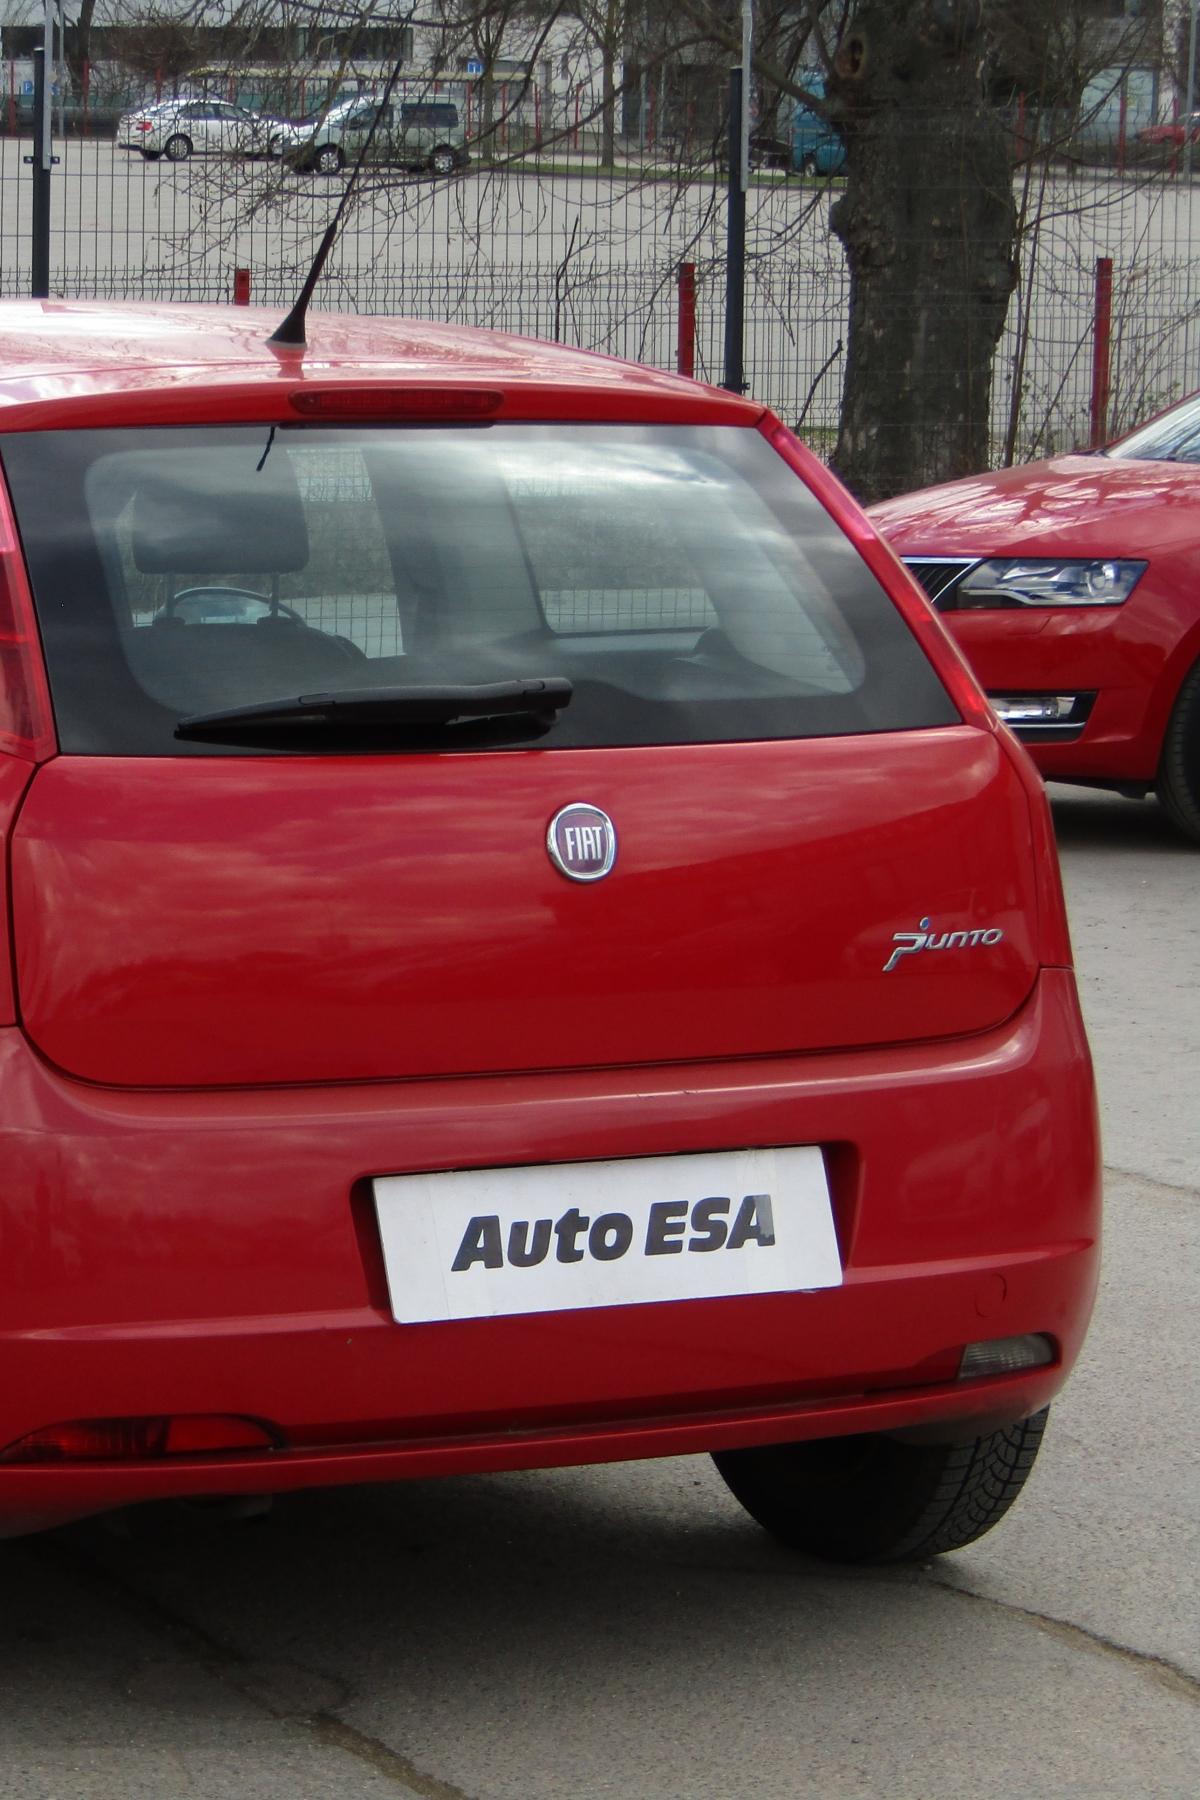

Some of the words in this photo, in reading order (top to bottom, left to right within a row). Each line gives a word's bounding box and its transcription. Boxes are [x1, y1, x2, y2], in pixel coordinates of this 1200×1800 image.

[565, 826, 602, 861] FIAT
[451, 1208, 633, 1271] Auto
[644, 1194, 776, 1256] ESA
